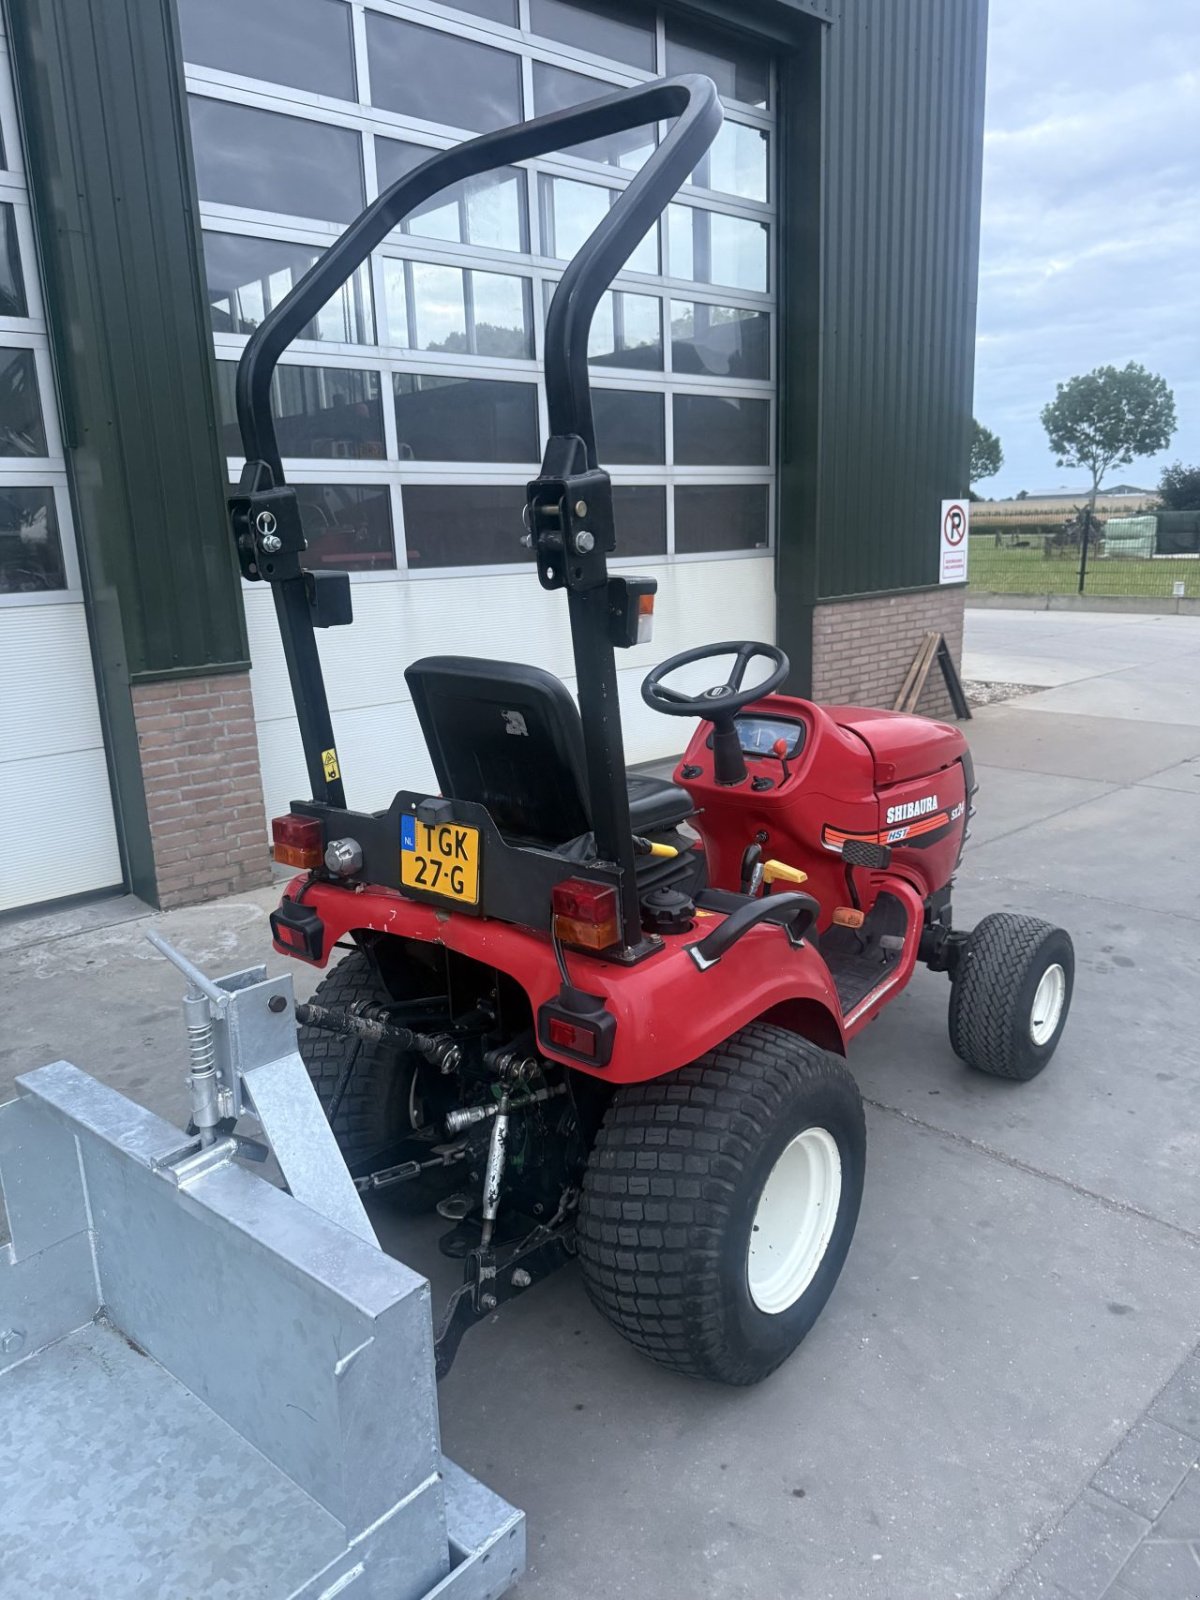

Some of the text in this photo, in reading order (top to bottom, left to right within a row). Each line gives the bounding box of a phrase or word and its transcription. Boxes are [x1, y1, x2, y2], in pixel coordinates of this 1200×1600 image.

[886, 795, 938, 824] SHIBAURA
[404, 836, 413, 846] NL
[423, 824, 468, 861] TGK
[888, 828, 908, 841] HST
